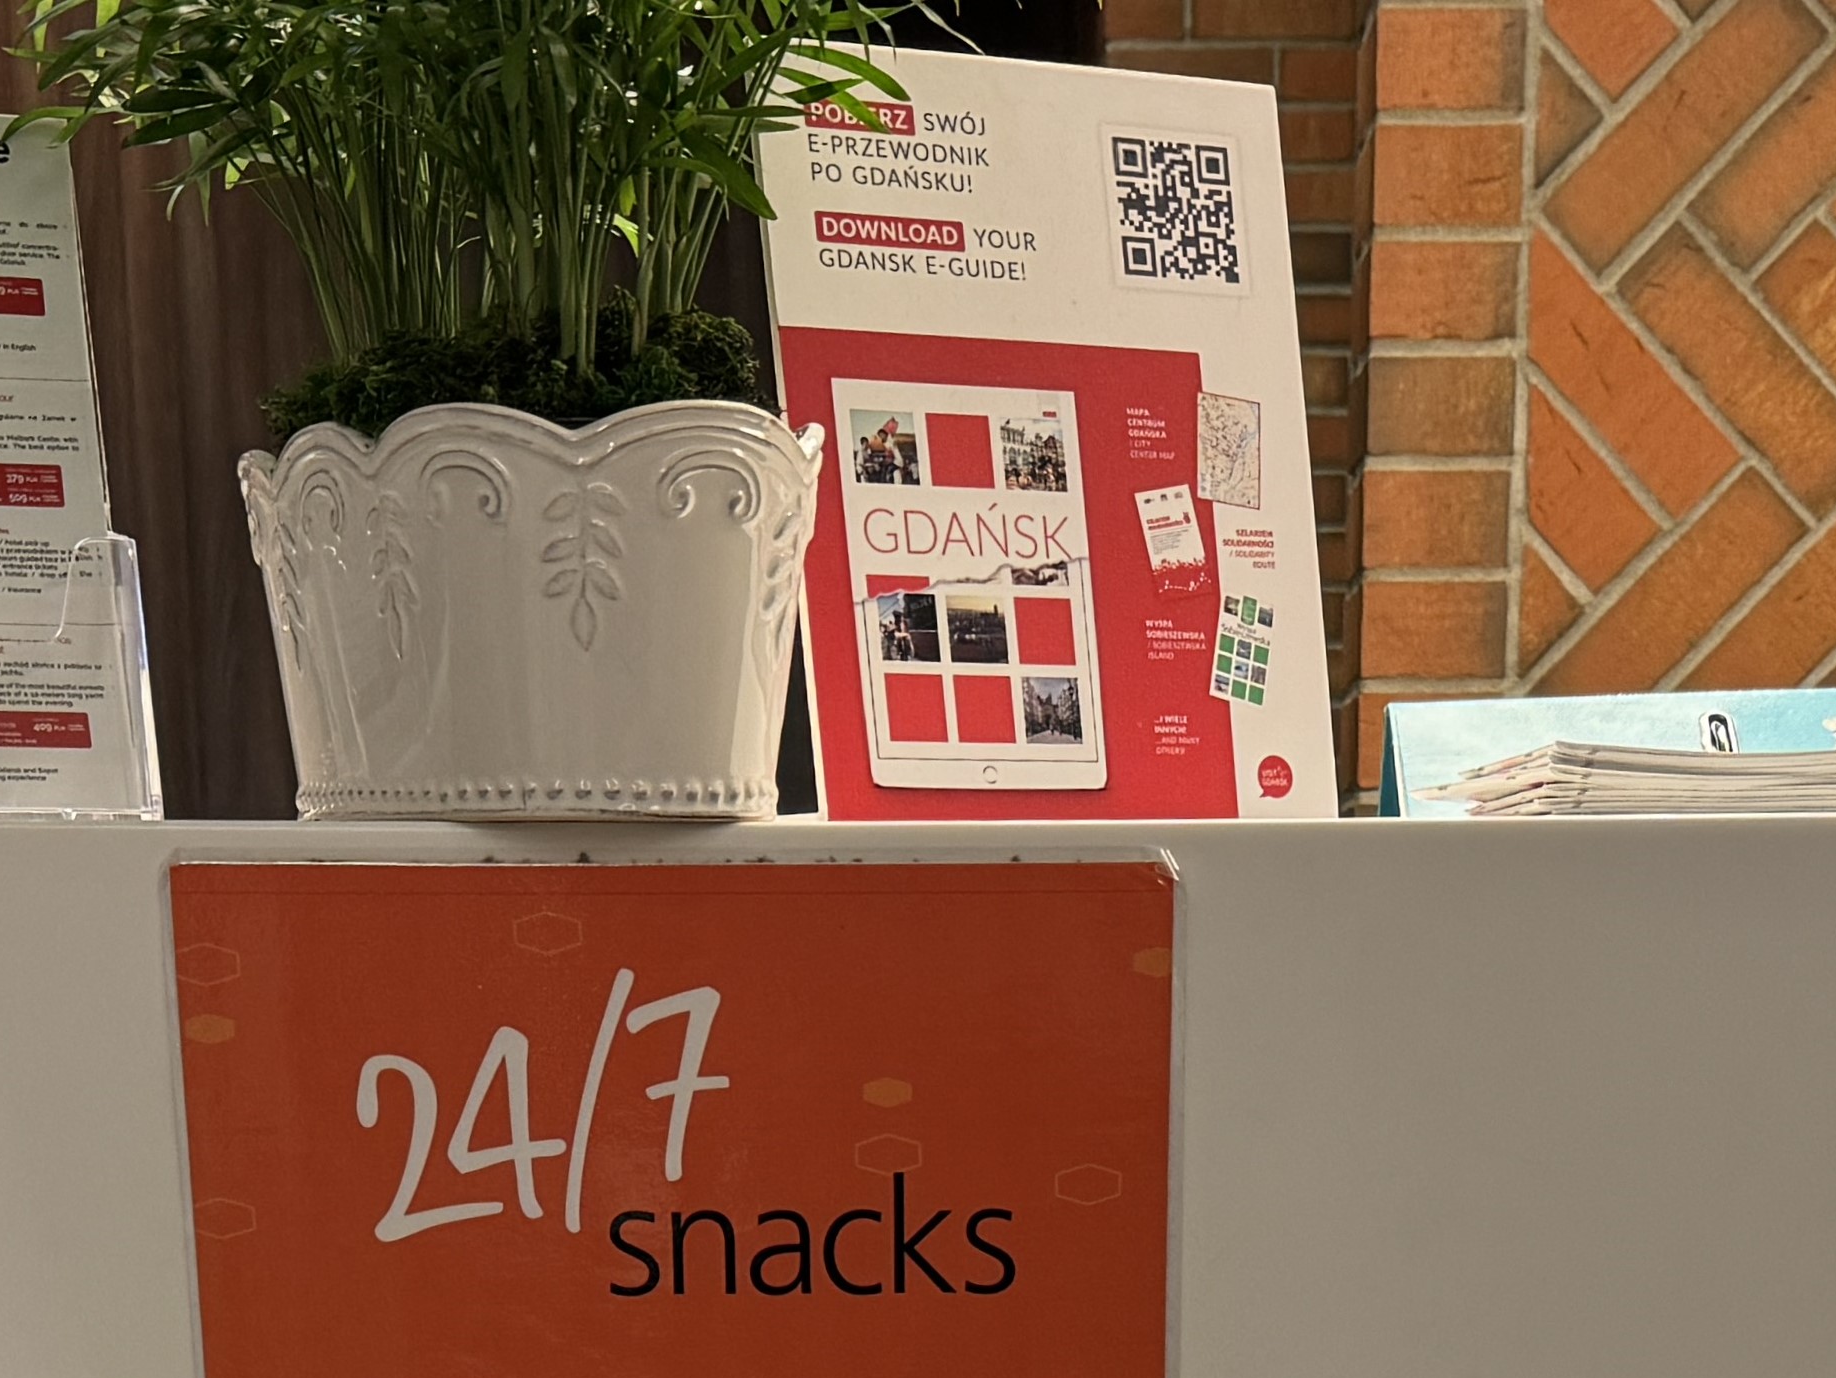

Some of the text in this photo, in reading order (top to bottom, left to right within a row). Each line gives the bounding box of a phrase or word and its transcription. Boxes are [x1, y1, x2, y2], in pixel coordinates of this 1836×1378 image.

[923, 109, 986, 137] SWÓJ
[808, 133, 990, 168] E-PRZEWODNIK
[811, 162, 974, 195] PO GDAŃSKU!
[822, 215, 1036, 251] DOWNLOAD YOUR
[819, 248, 1027, 282] GDANSK E-GUIDE!
[863, 503, 1071, 560] GDAŃSK
[355, 967, 730, 1243] 24/7
[607, 1171, 1018, 1297] snacks
